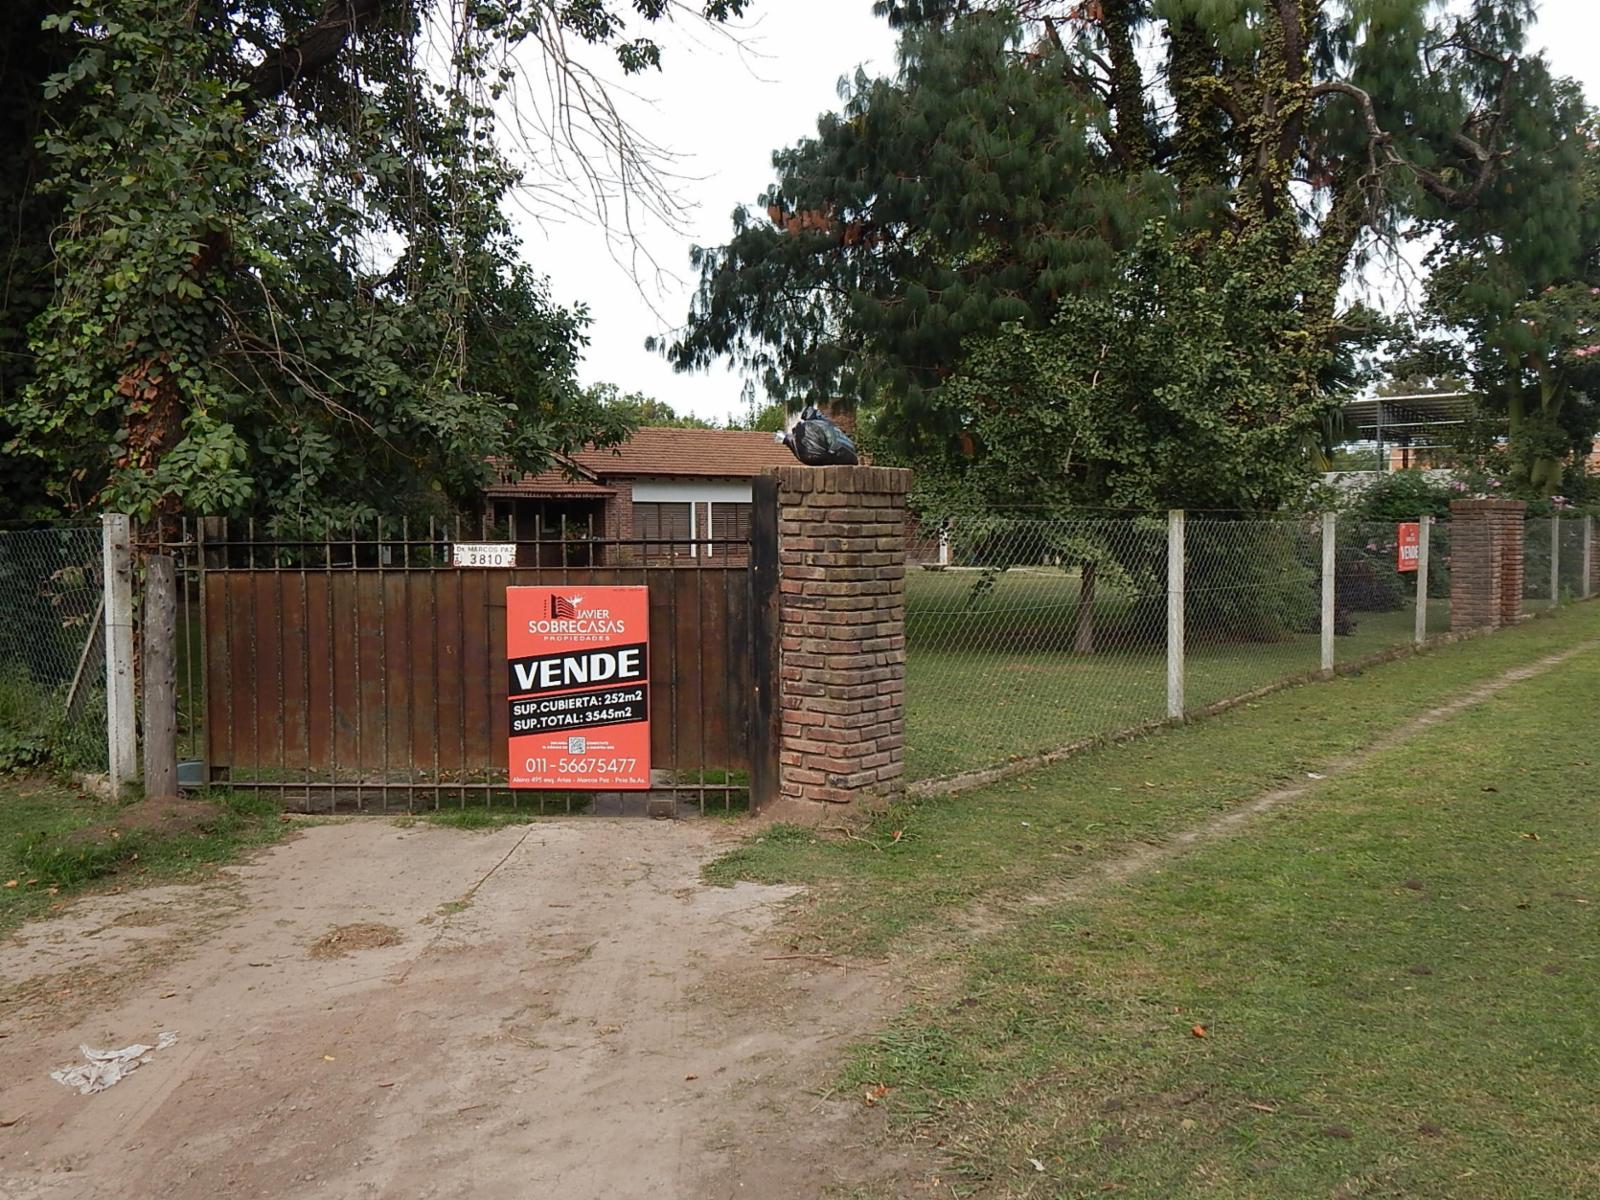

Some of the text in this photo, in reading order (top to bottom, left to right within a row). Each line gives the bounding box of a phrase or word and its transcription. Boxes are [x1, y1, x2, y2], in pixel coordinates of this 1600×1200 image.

[470, 553, 502, 565] 3810
[577, 609, 609, 620] JAVIER
[528, 620, 625, 633] SOBRECASAS
[514, 648, 640, 691] VENDE
[604, 690, 642, 705] 252m2
[585, 707, 632, 722] 3545m2
